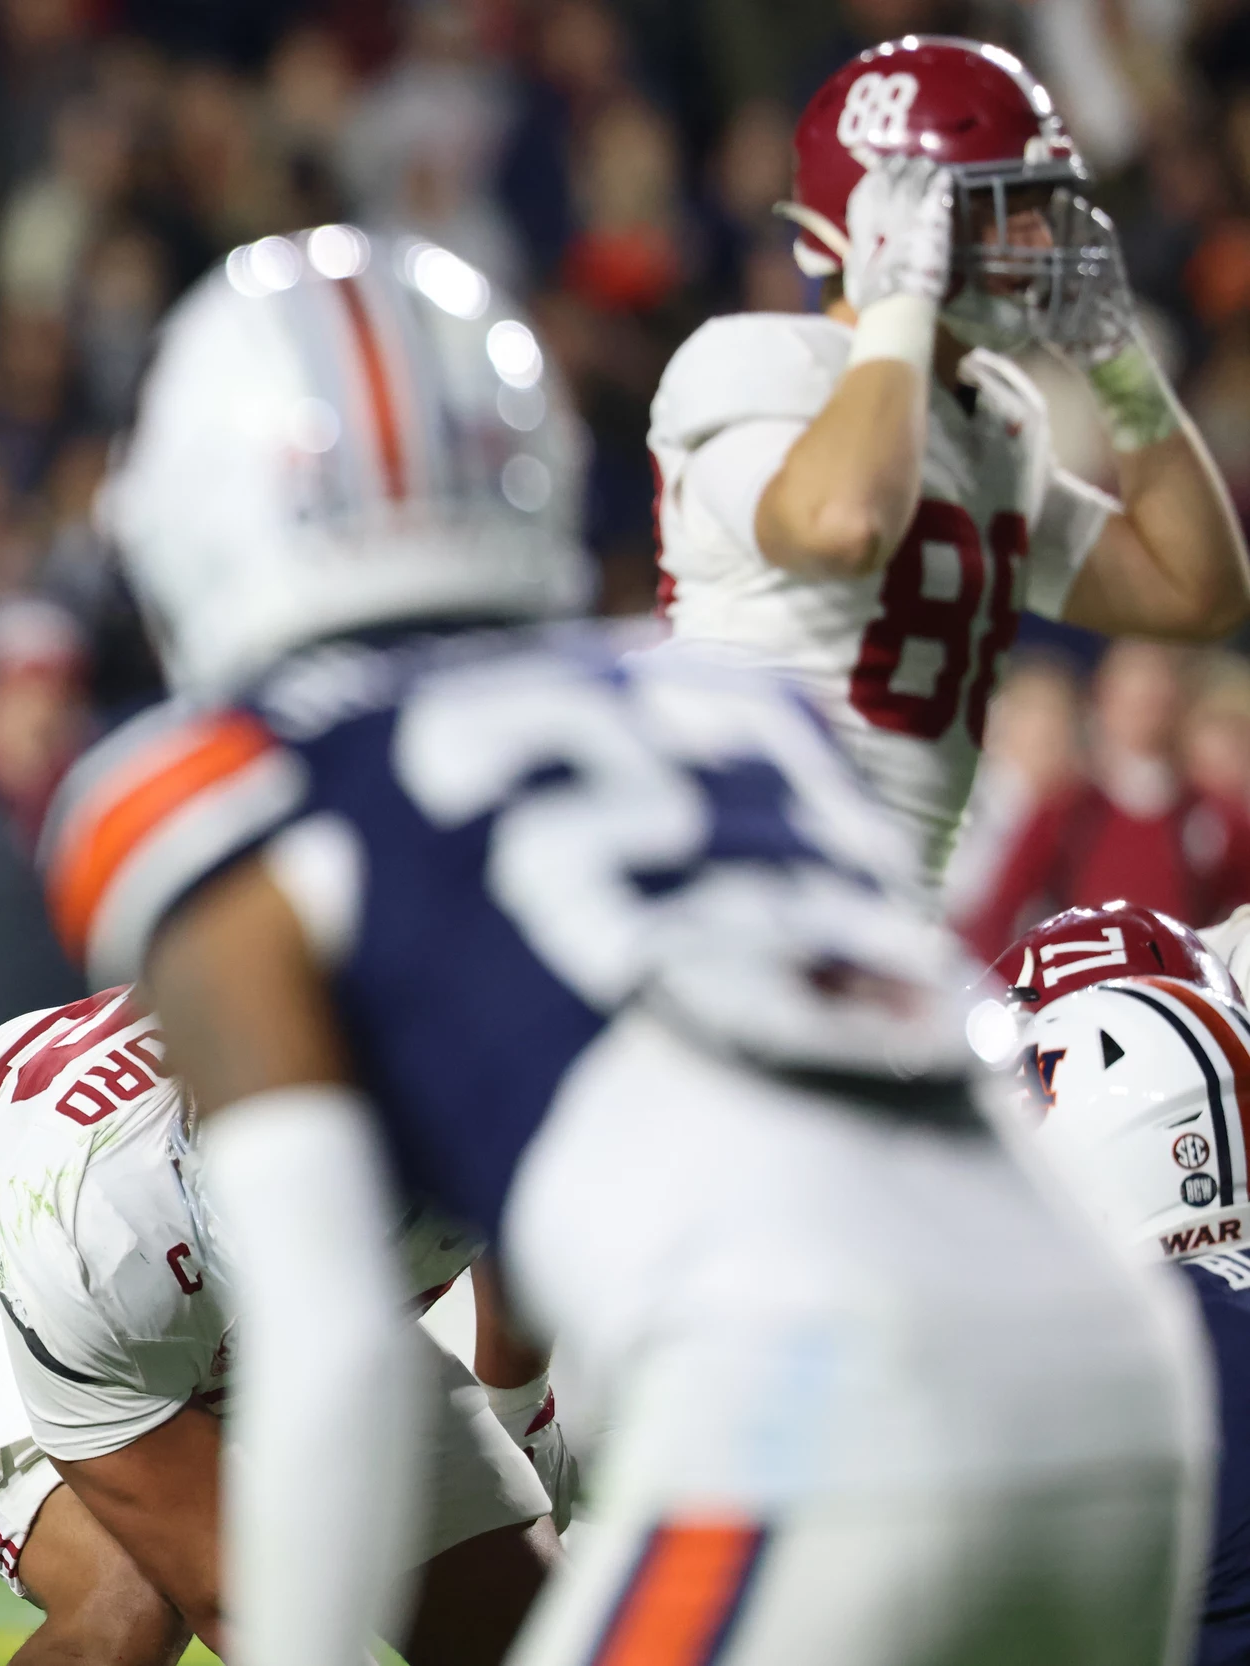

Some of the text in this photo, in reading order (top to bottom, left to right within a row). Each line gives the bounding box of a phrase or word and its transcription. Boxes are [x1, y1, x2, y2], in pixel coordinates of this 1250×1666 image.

[837, 71, 920, 148] 88
[1039, 926, 1128, 989] 71
[1175, 1134, 1207, 1169] SEC
[1159, 1218, 1242, 1257] WAR
[166, 1241, 204, 1296] C
